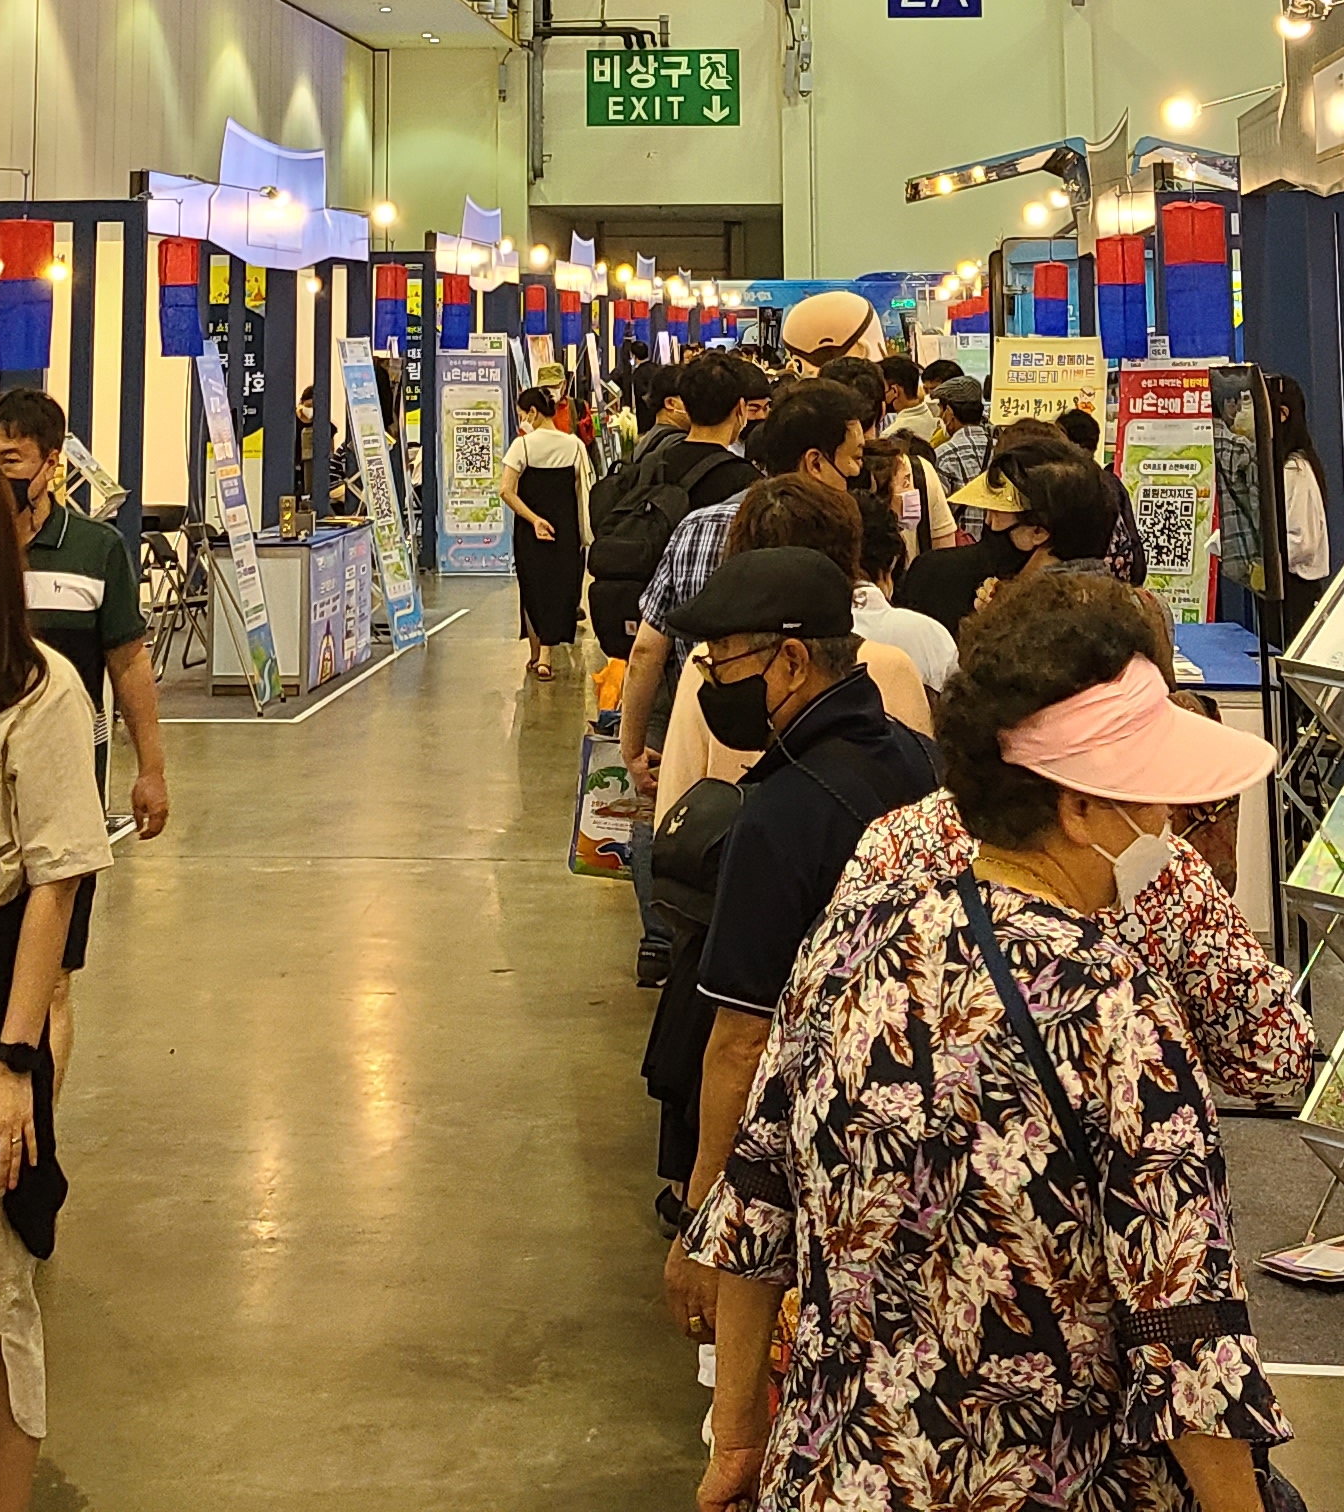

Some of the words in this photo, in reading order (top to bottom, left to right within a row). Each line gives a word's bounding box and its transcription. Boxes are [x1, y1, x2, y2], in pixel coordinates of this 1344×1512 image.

[593, 55, 692, 89] 비상구
[608, 97, 684, 120] EXIT
[1129, 390, 1181, 414] 내손안에
